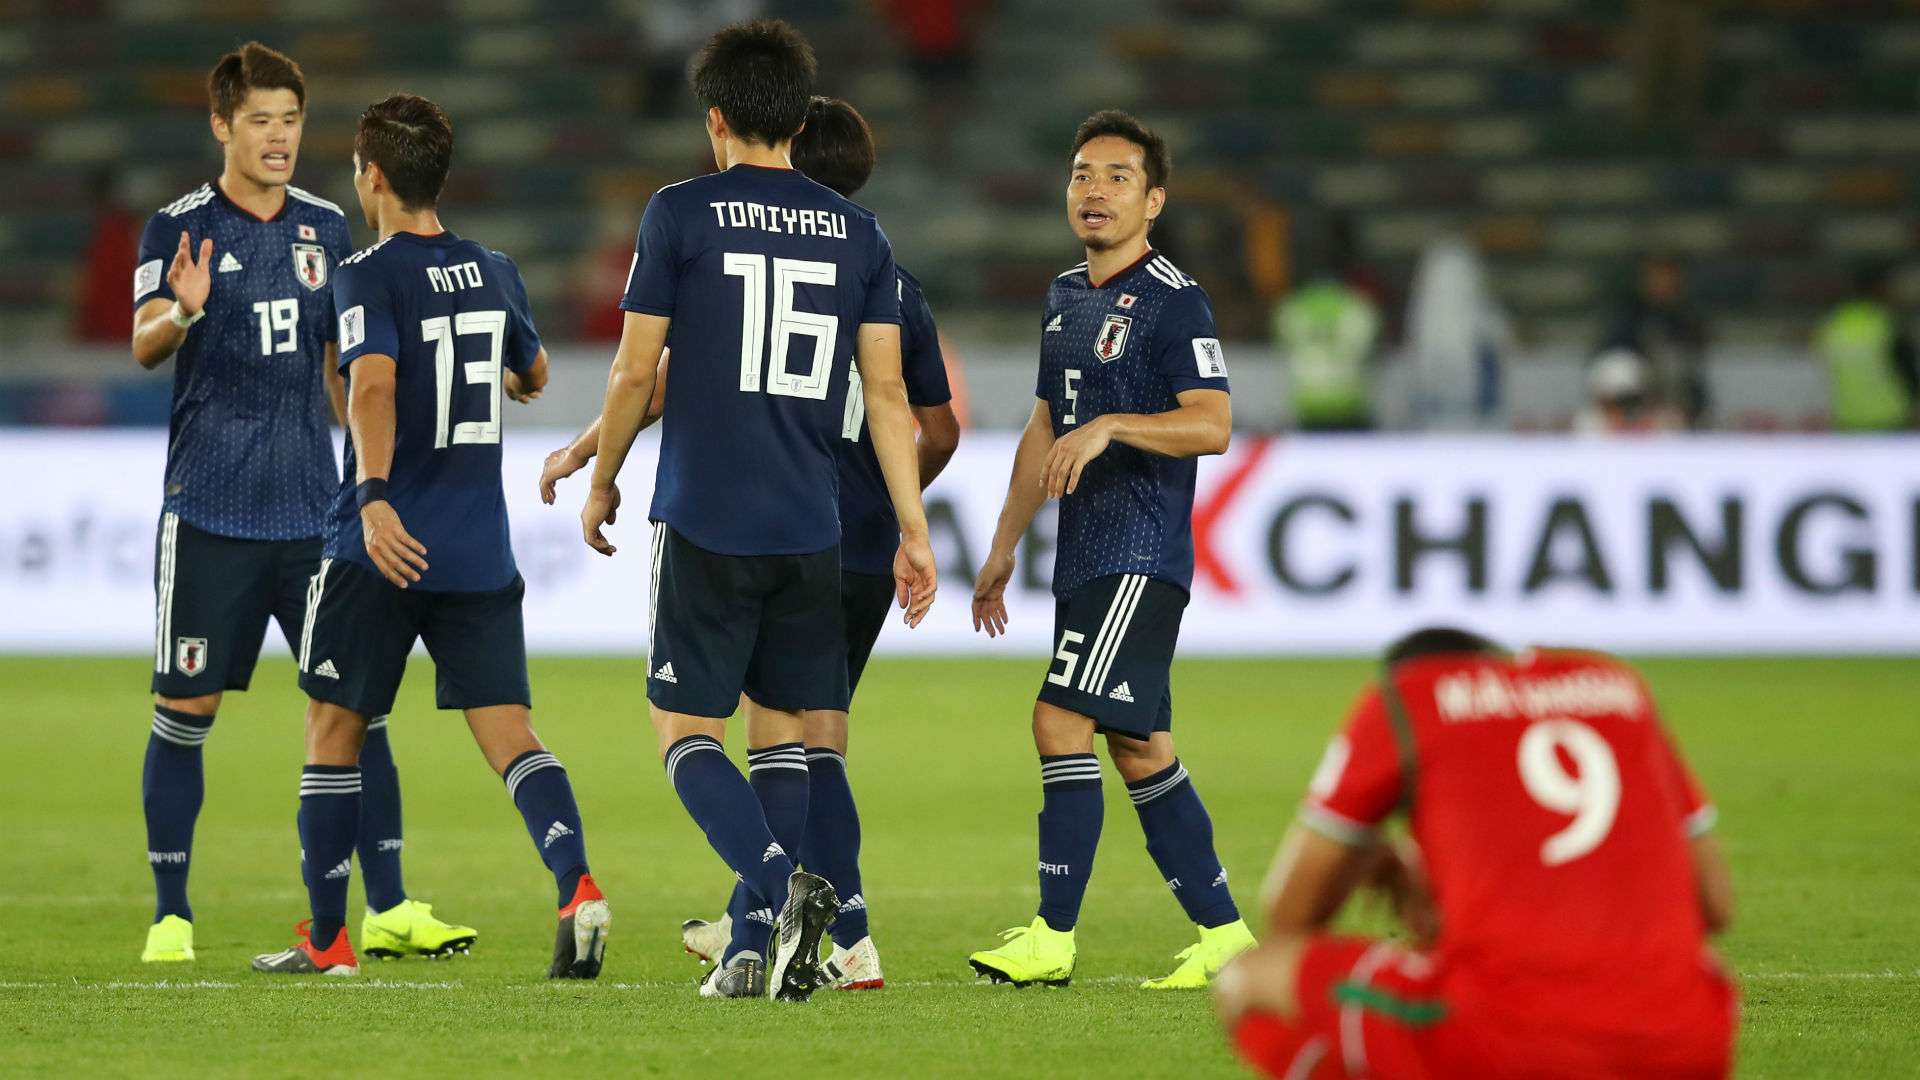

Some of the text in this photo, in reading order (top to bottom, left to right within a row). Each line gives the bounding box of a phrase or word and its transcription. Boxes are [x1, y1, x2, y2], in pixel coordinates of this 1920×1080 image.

[710, 201, 848, 240] TOMIYASU
[426, 260, 484, 293] MITO
[253, 298, 299, 356] 19
[723, 252, 839, 401] 16
[421, 310, 506, 449] 13
[1062, 368, 1082, 425] 5
[1191, 434, 1920, 604] CHANG
[1048, 629, 1086, 687] 5
[1516, 717, 1622, 866] 9
[1038, 861, 1069, 875] PAN
